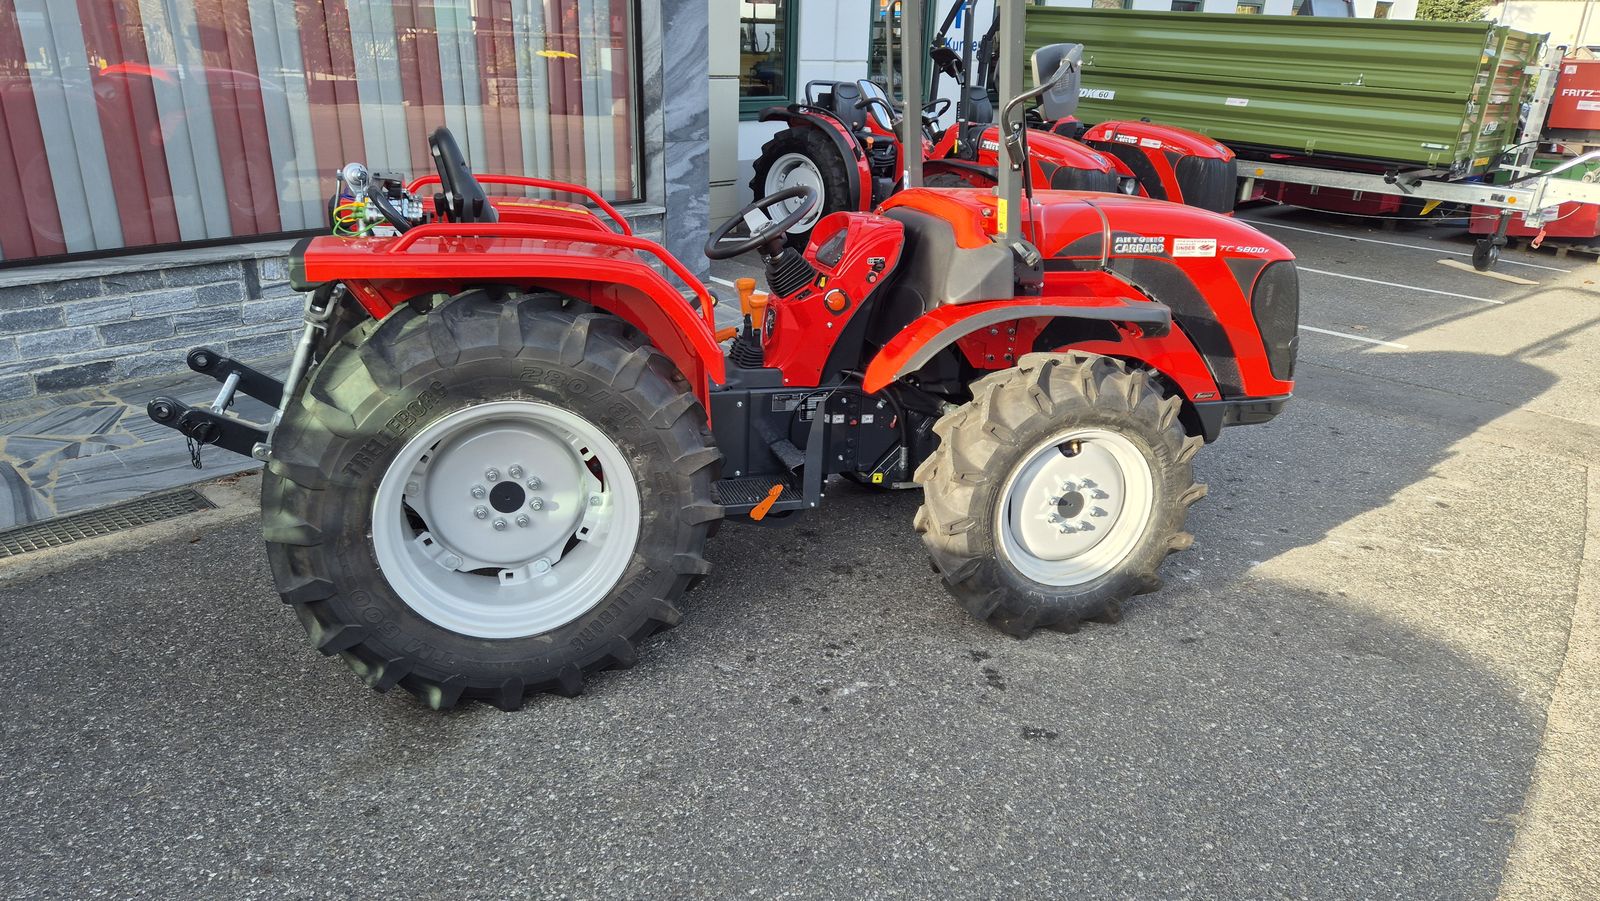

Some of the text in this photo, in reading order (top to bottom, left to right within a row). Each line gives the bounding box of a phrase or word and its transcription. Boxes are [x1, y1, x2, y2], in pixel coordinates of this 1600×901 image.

[1562, 88, 1594, 97] FRITZ
[1115, 236, 1165, 244] ANTONIO
[1114, 243, 1165, 254] CARRARO
[342, 380, 449, 479] TRELLEBORG
[569, 566, 659, 652] TRELLEBORG
